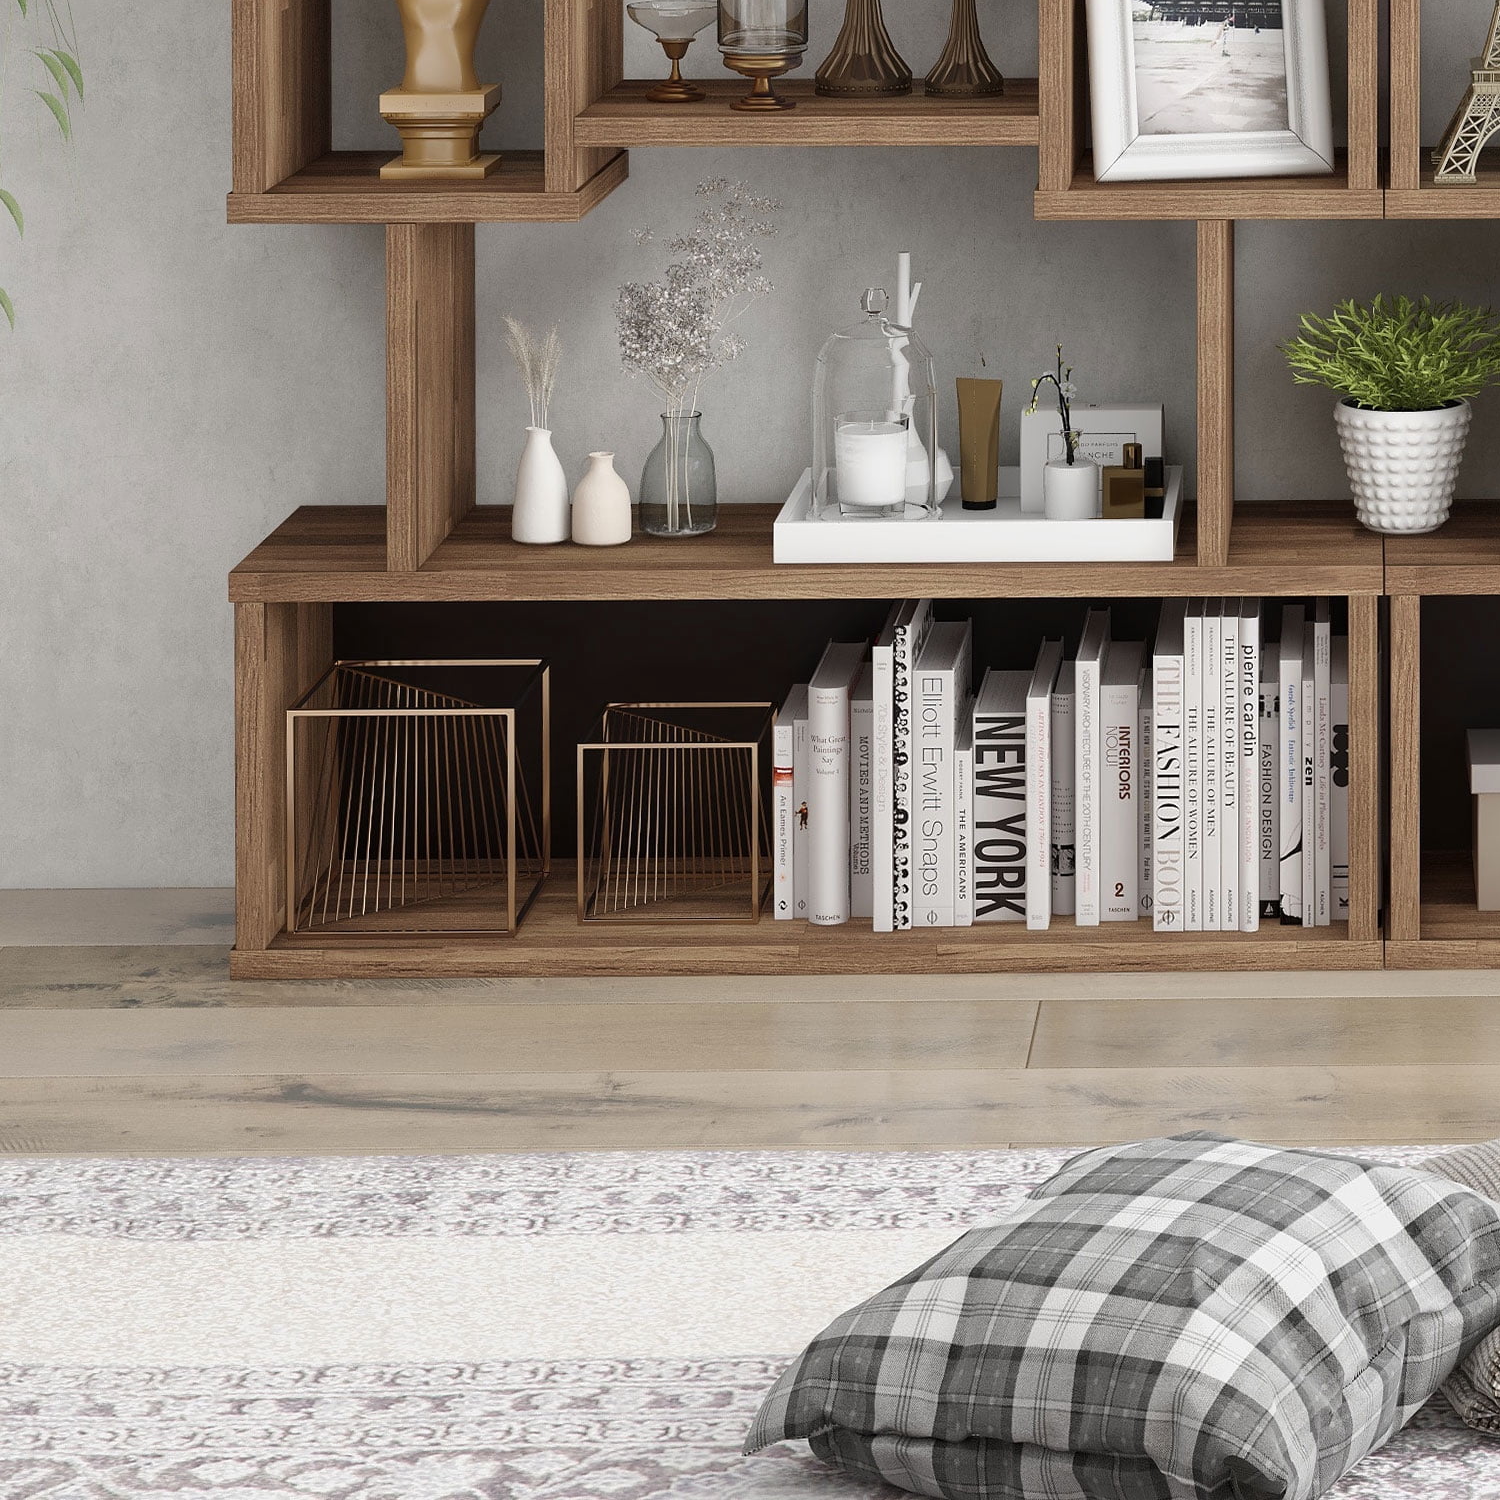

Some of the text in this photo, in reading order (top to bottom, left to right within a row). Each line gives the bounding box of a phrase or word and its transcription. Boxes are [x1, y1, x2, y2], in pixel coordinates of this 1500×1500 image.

[1225, 635, 1235, 665] THE
[1081, 669, 1091, 708] VISIONARY
[1157, 658, 1181, 716] THE
[1225, 668, 1235, 725] ALLURE
[1241, 644, 1256, 757] pierre cardin
[811, 735, 827, 744] What
[1081, 709, 1091, 770] ARCHITECTURE
[1188, 706, 1198, 733] THE
[1207, 706, 1216, 733] THE
[1225, 728, 1235, 747] OF
[821, 756, 833, 765] Say
[1106, 726, 1118, 767] NOW!
[1119, 726, 1131, 800] INTERIORS
[1188, 735, 1198, 787] ALLURE
[1207, 735, 1216, 786] ALLURE
[918, 677, 943, 896] Elliott Erwitt Snaps
[1081, 771, 1091, 783] OF
[1157, 724, 1181, 841] FASHION
[1225, 750, 1235, 810] BEAUTY
[1304, 757, 1313, 786] zen
[859, 736, 869, 875] MOVIES AND METHODS
[1081, 784, 1091, 801] THE
[1188, 789, 1198, 807] OF
[1207, 788, 1216, 806] OF
[1261, 744, 1272, 861] FASHION DESIGN
[975, 716, 1026, 918] NEW YORK
[1188, 808, 1198, 860] WOMEN
[1207, 808, 1216, 837] MEN
[1081, 827, 1091, 870] CENTURY
[1114, 882, 1124, 898] 2
[815, 913, 841, 922] TASCHEN
